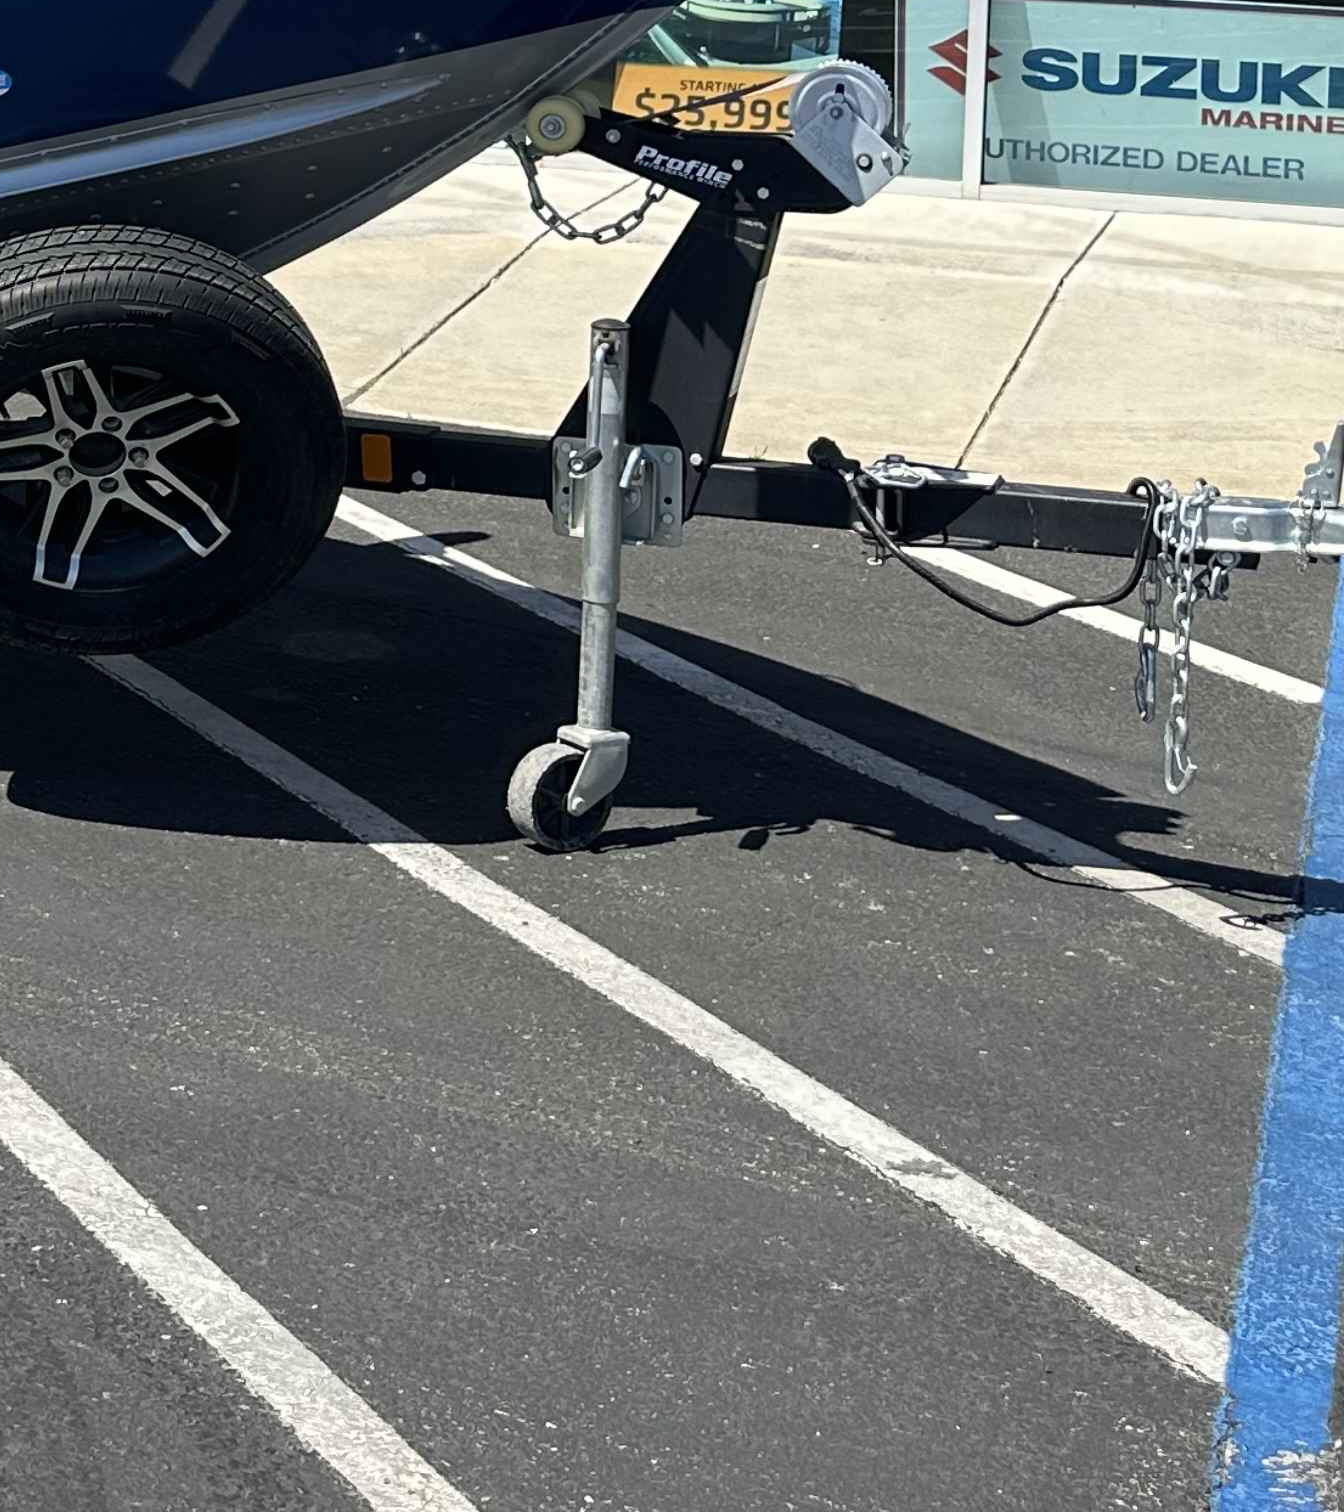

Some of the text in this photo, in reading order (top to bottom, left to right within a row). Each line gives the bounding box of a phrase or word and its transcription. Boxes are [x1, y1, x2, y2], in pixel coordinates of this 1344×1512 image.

[1200, 107, 1344, 135] MARINE
[635, 144, 733, 183] Profile
[986, 137, 1305, 181] UTHORIZED DEALER
